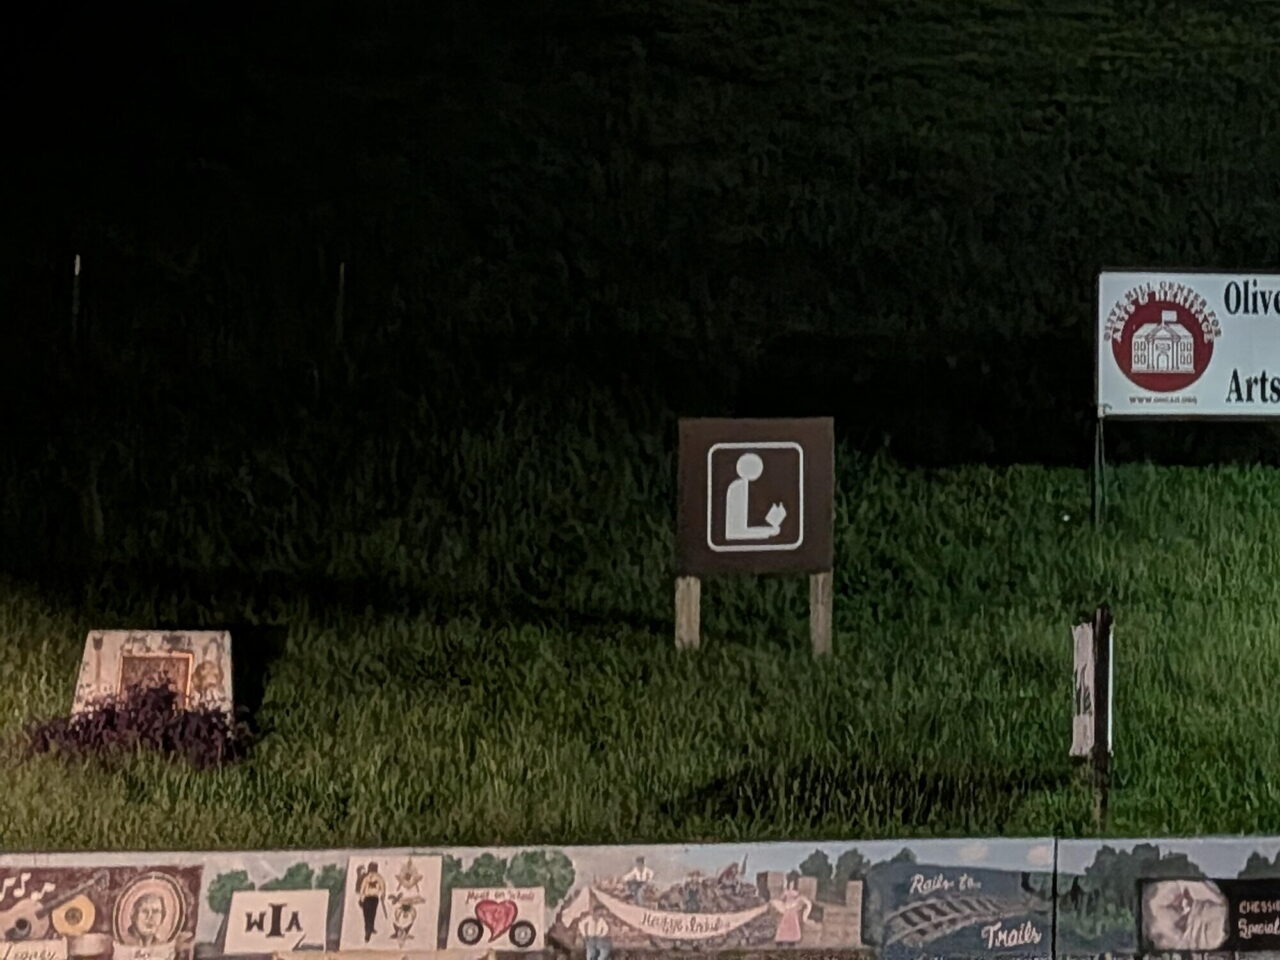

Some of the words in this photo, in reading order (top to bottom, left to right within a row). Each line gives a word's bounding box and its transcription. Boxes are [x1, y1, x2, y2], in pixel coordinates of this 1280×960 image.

[1125, 282, 1153, 300] HILL
[1160, 281, 1207, 308] CENTER
[981, 920, 1042, 949] Trails
